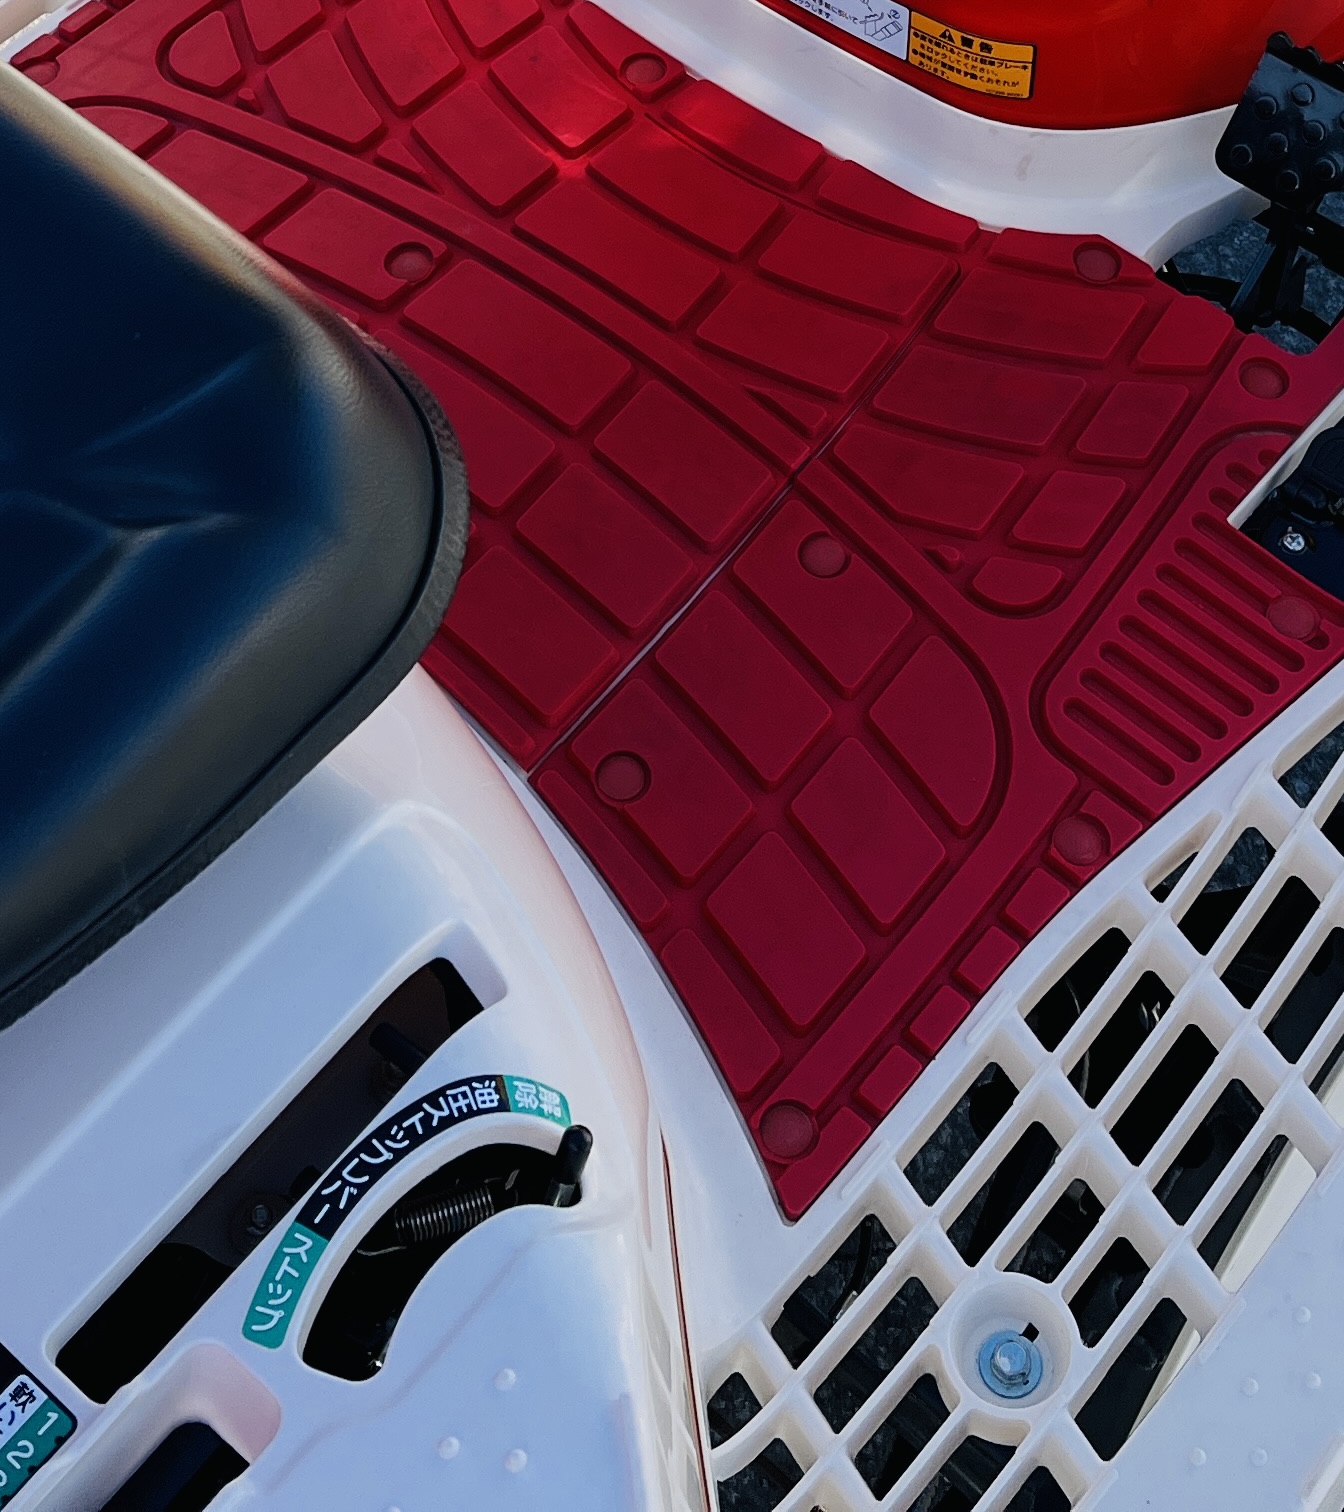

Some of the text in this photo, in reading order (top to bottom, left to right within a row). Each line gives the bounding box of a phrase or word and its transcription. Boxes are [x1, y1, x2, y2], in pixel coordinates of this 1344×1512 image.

[314, 1080, 501, 1224] 油圧ストップレバー
[251, 1232, 313, 1331] ストップ
[6, 1440, 35, 1470] 2
[37, 1411, 60, 1436] 1
